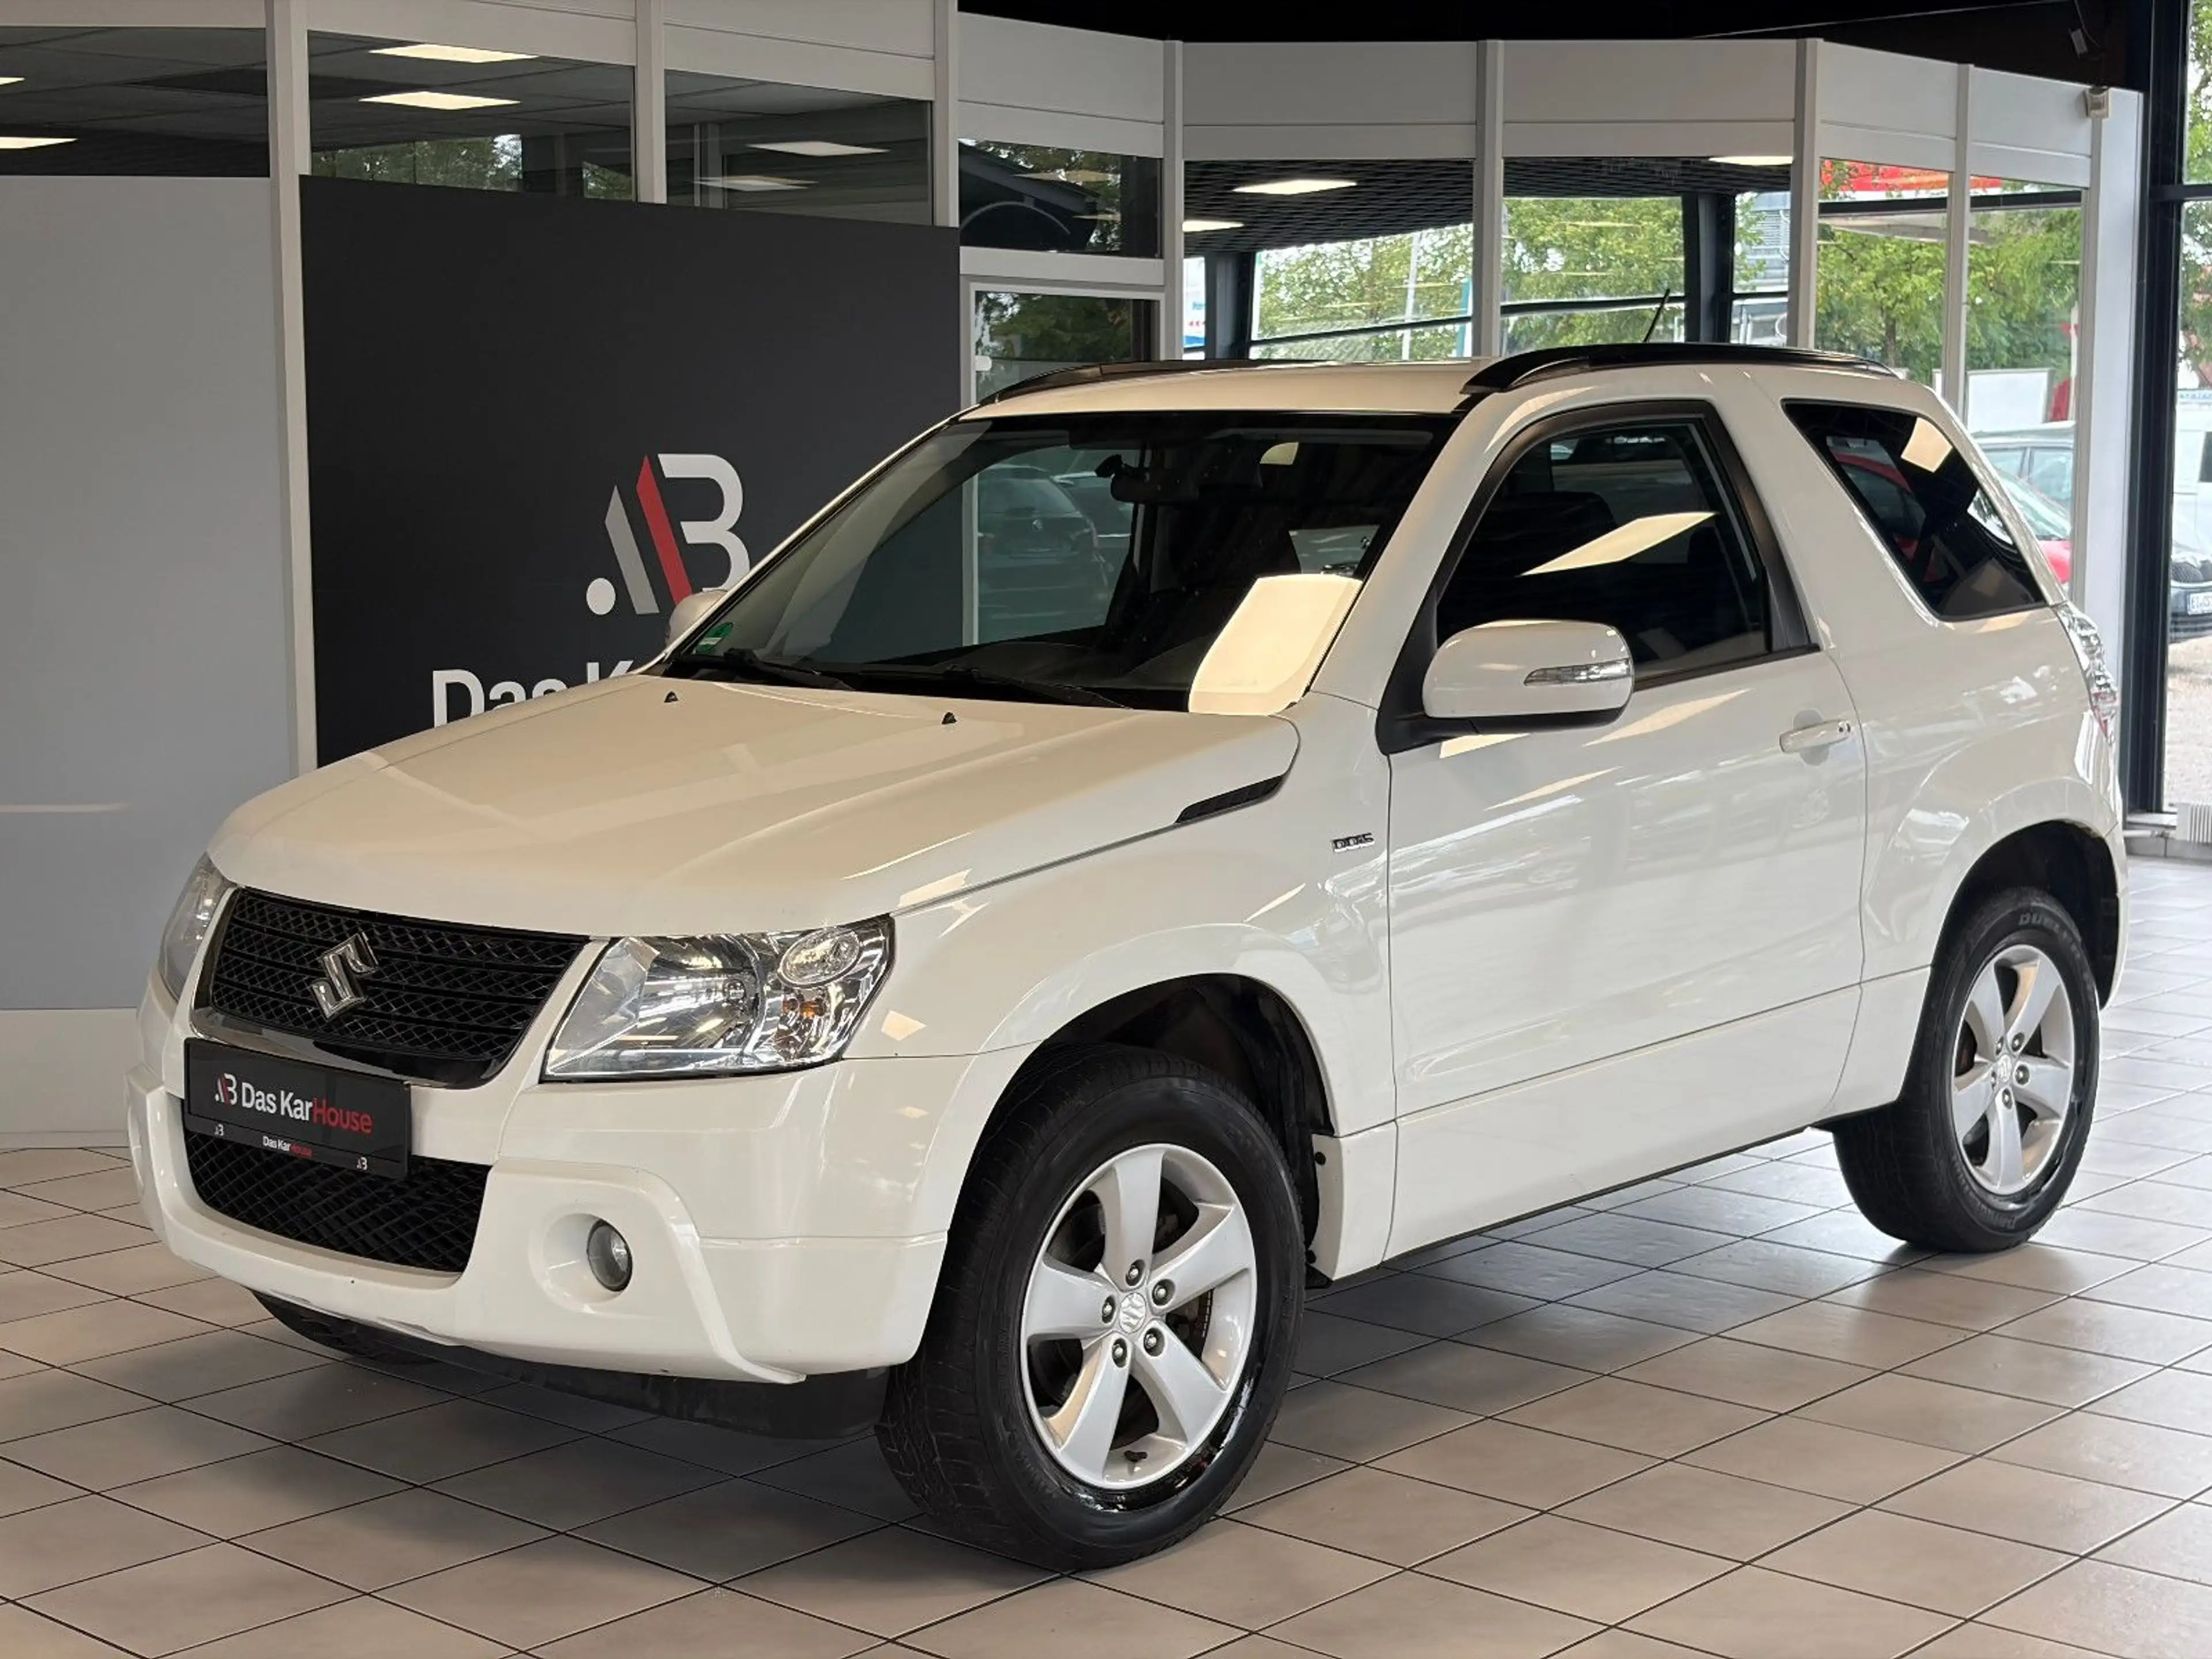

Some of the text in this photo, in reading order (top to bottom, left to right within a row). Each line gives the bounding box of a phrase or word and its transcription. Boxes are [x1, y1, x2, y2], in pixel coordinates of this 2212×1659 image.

[242, 1082, 277, 1113] Das
[280, 1090, 373, 1134] KarHouse
[262, 1136, 277, 1149] Das
